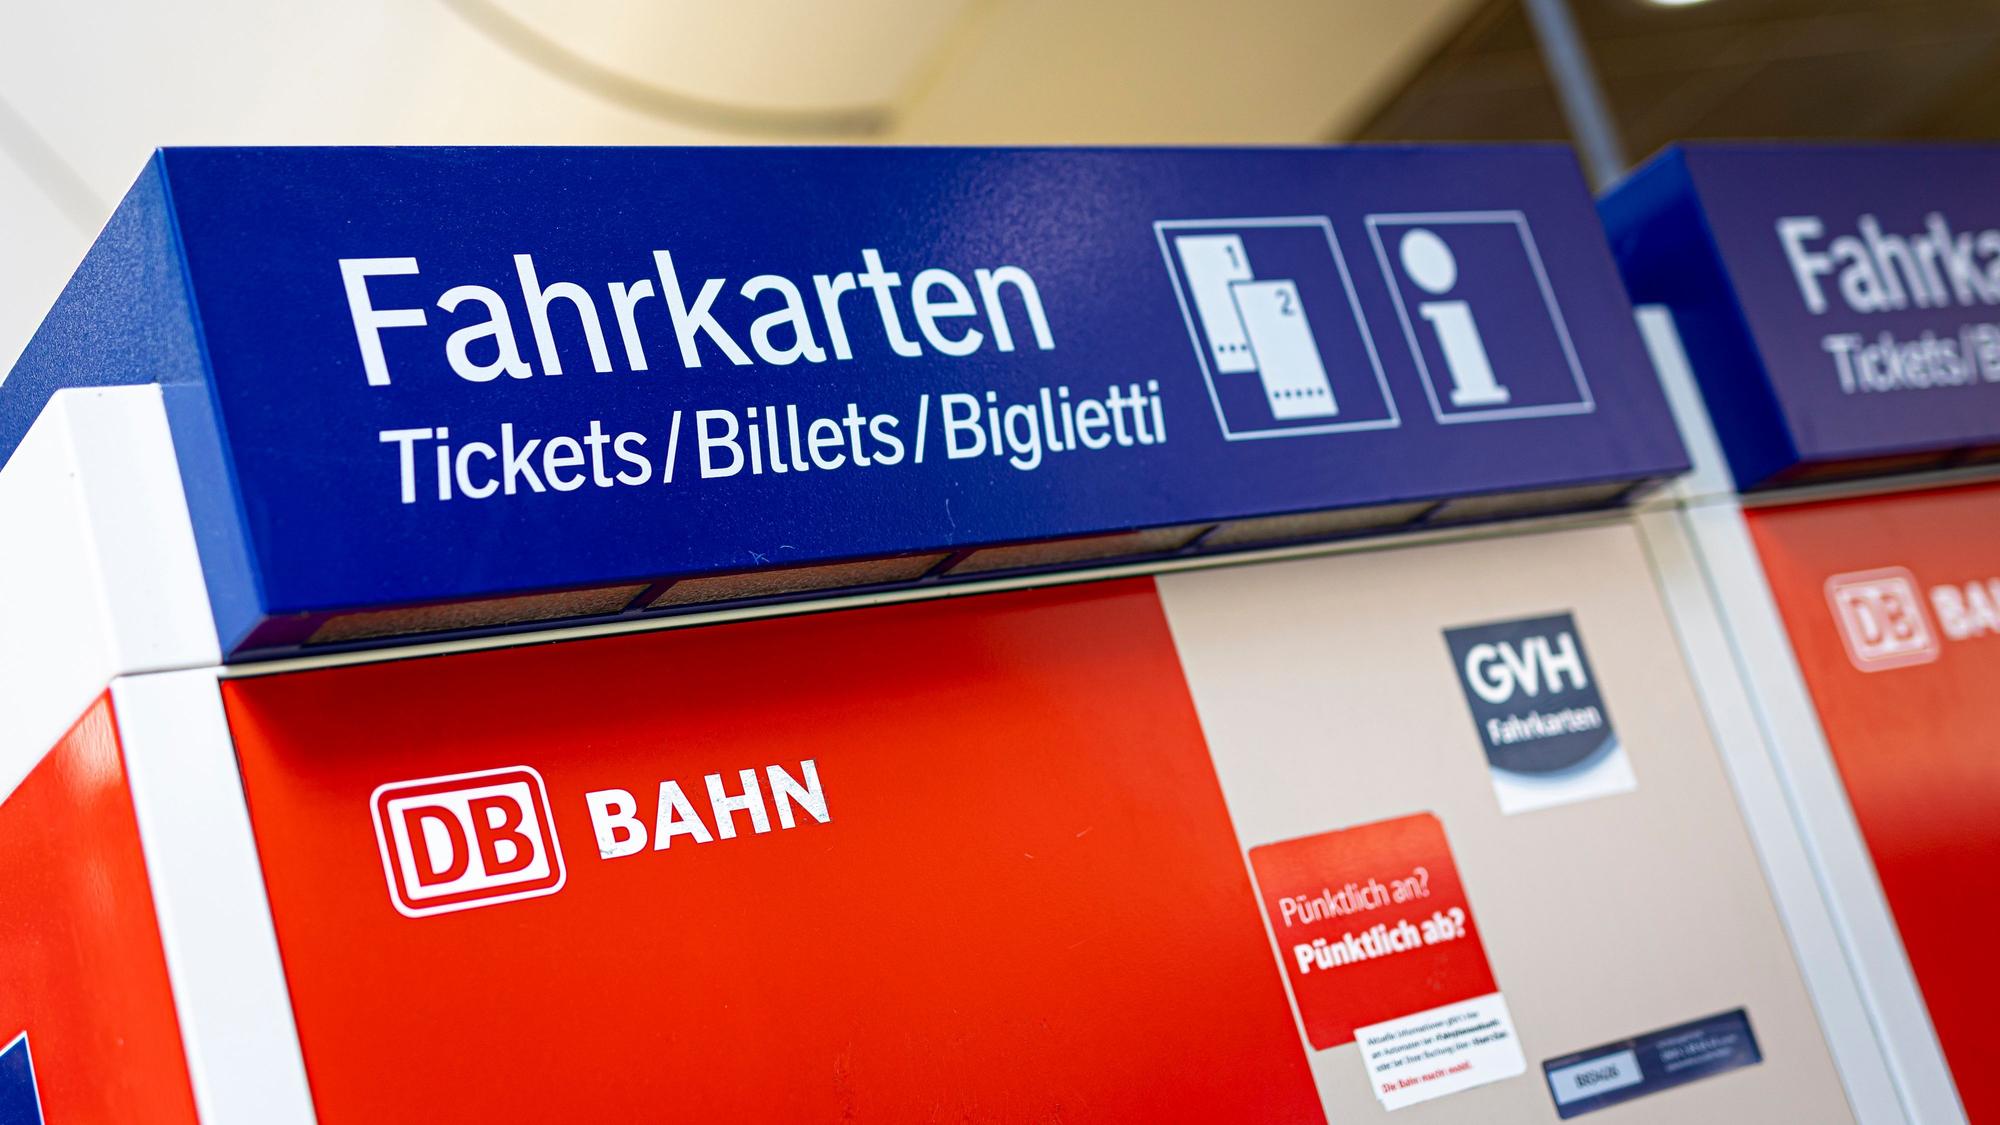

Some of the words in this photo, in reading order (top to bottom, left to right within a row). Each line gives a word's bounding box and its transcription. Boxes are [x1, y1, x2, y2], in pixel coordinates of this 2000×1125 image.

[338, 249, 1056, 387] Fahrkarten
[1274, 288, 1296, 316] 2
[1929, 576, 2000, 641] BA
[1465, 632, 1588, 704] GVH
[1486, 705, 1603, 746] Fahrkarten
[402, 794, 535, 888] DB
[585, 759, 832, 860] BAHN
[1279, 877, 1390, 928] Pünktlich
[1390, 866, 1431, 904] an?
[1294, 918, 1422, 974] Pünktlich
[1420, 906, 1466, 946] ab?
